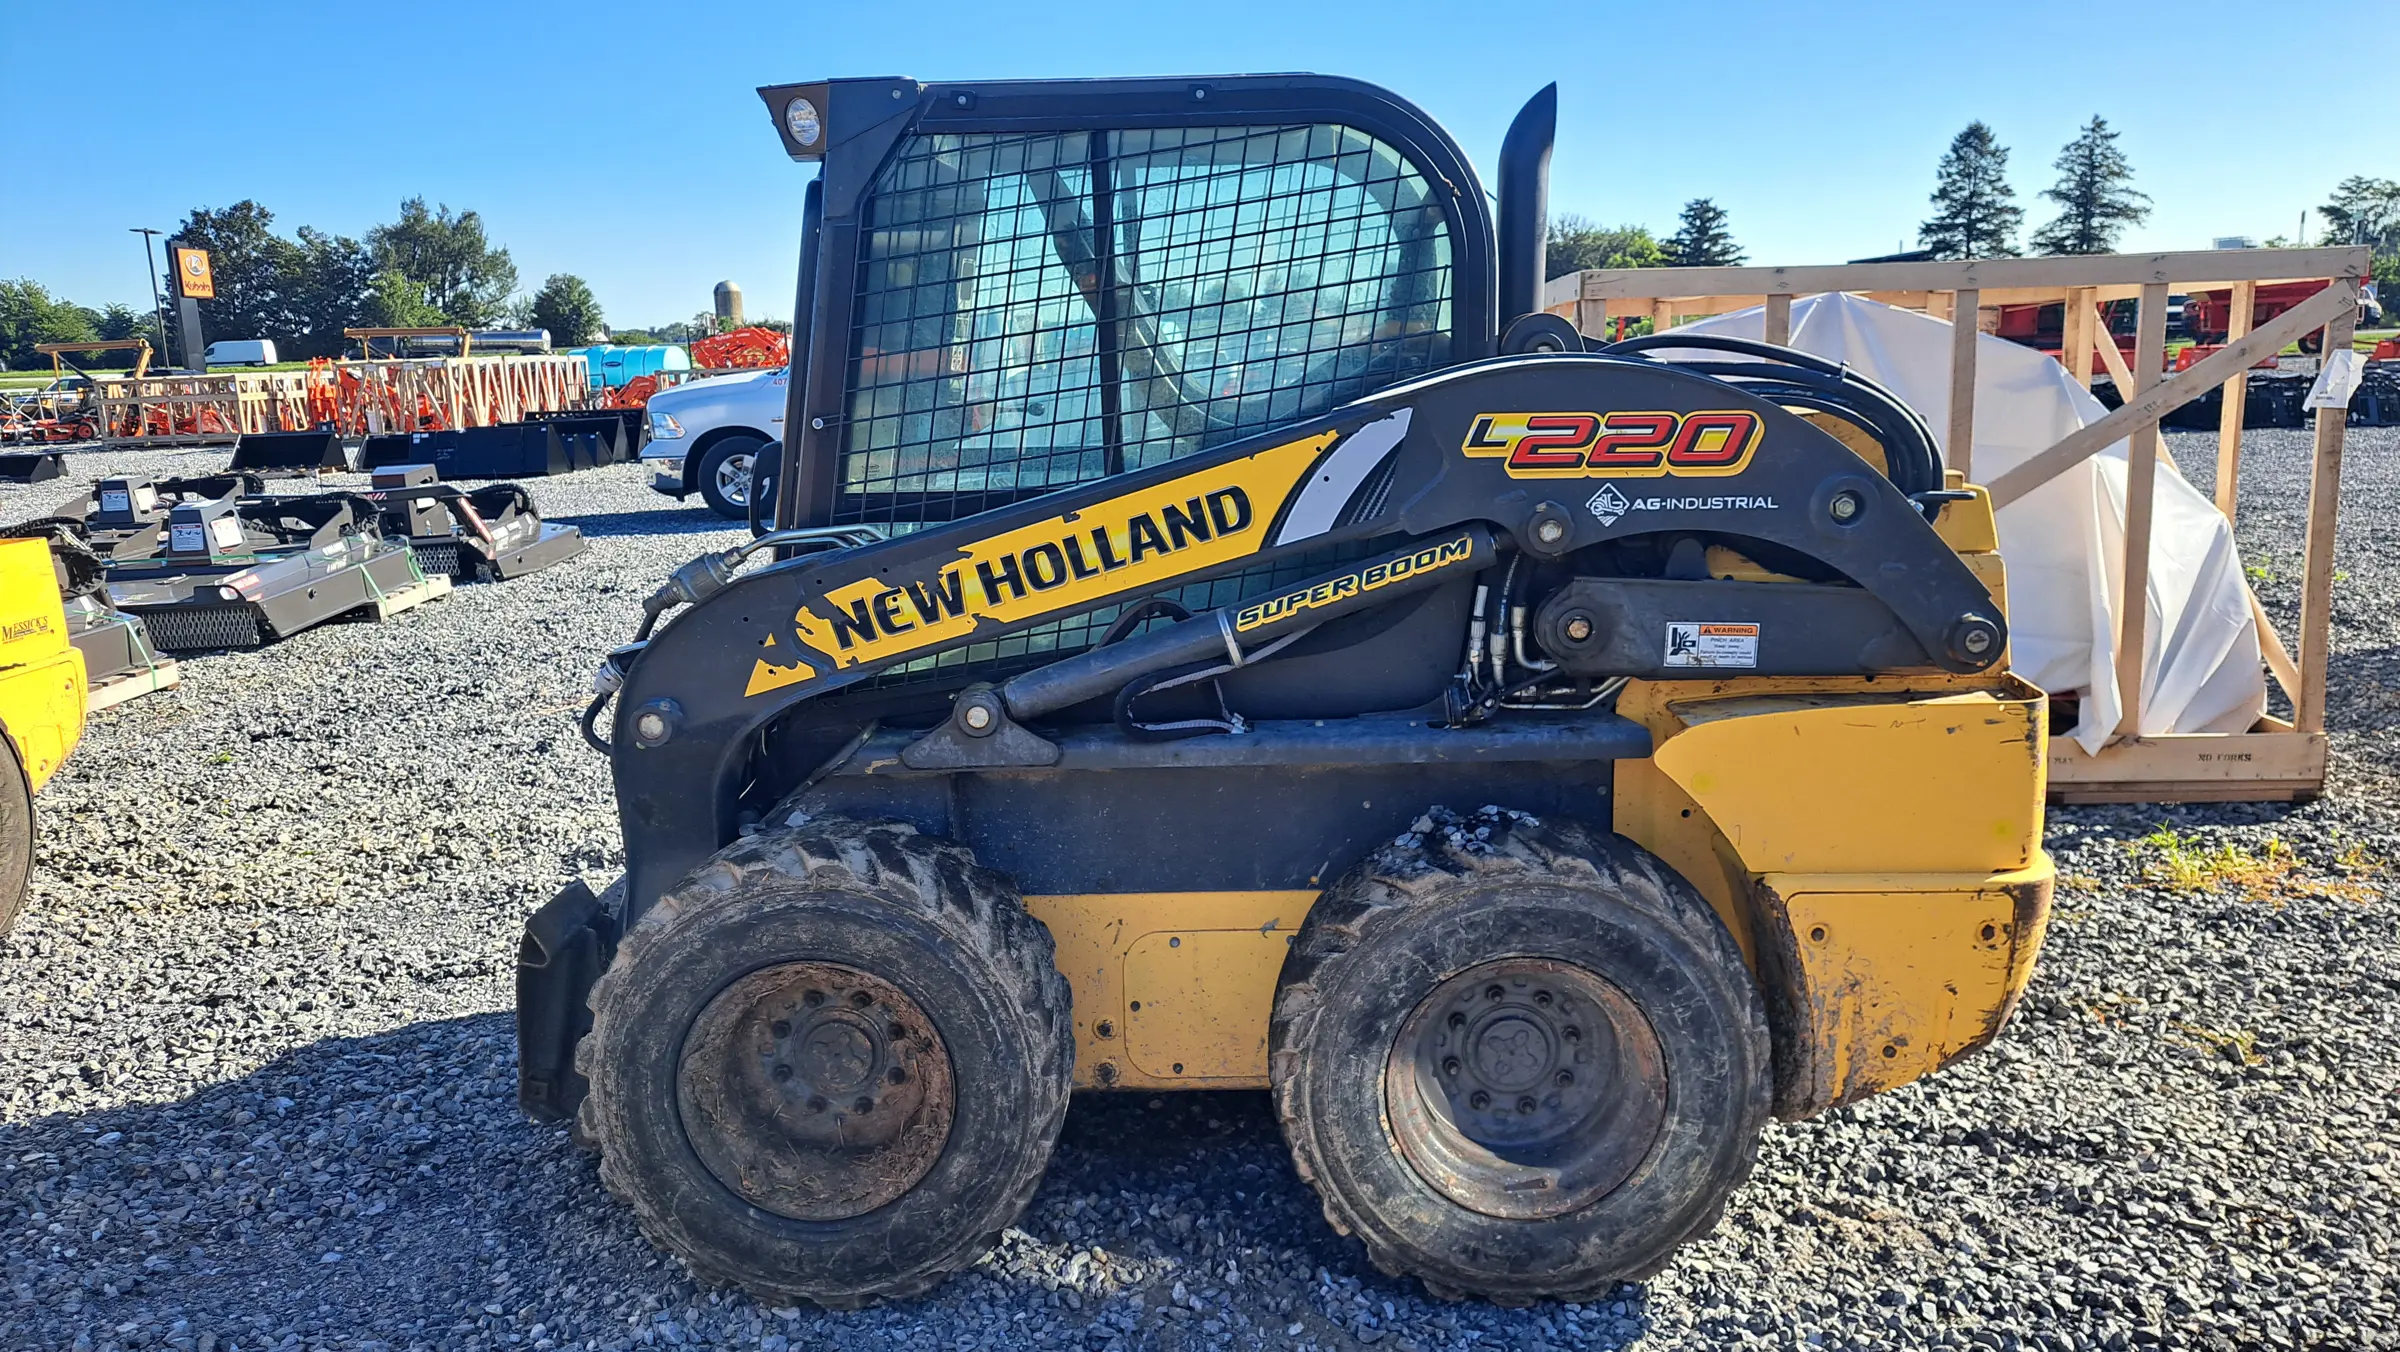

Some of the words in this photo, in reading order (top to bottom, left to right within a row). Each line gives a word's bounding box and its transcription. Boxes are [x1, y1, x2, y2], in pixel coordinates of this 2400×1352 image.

[184, 280, 211, 292] Kubota
[1461, 410, 1765, 479] L220
[1631, 496, 1780, 511] AG-INDUSTRIAL
[830, 568, 967, 651] NEW
[974, 484, 1254, 608] HOLLAND
[1236, 573, 1360, 632] SUPER
[1361, 536, 1473, 590] BOOM
